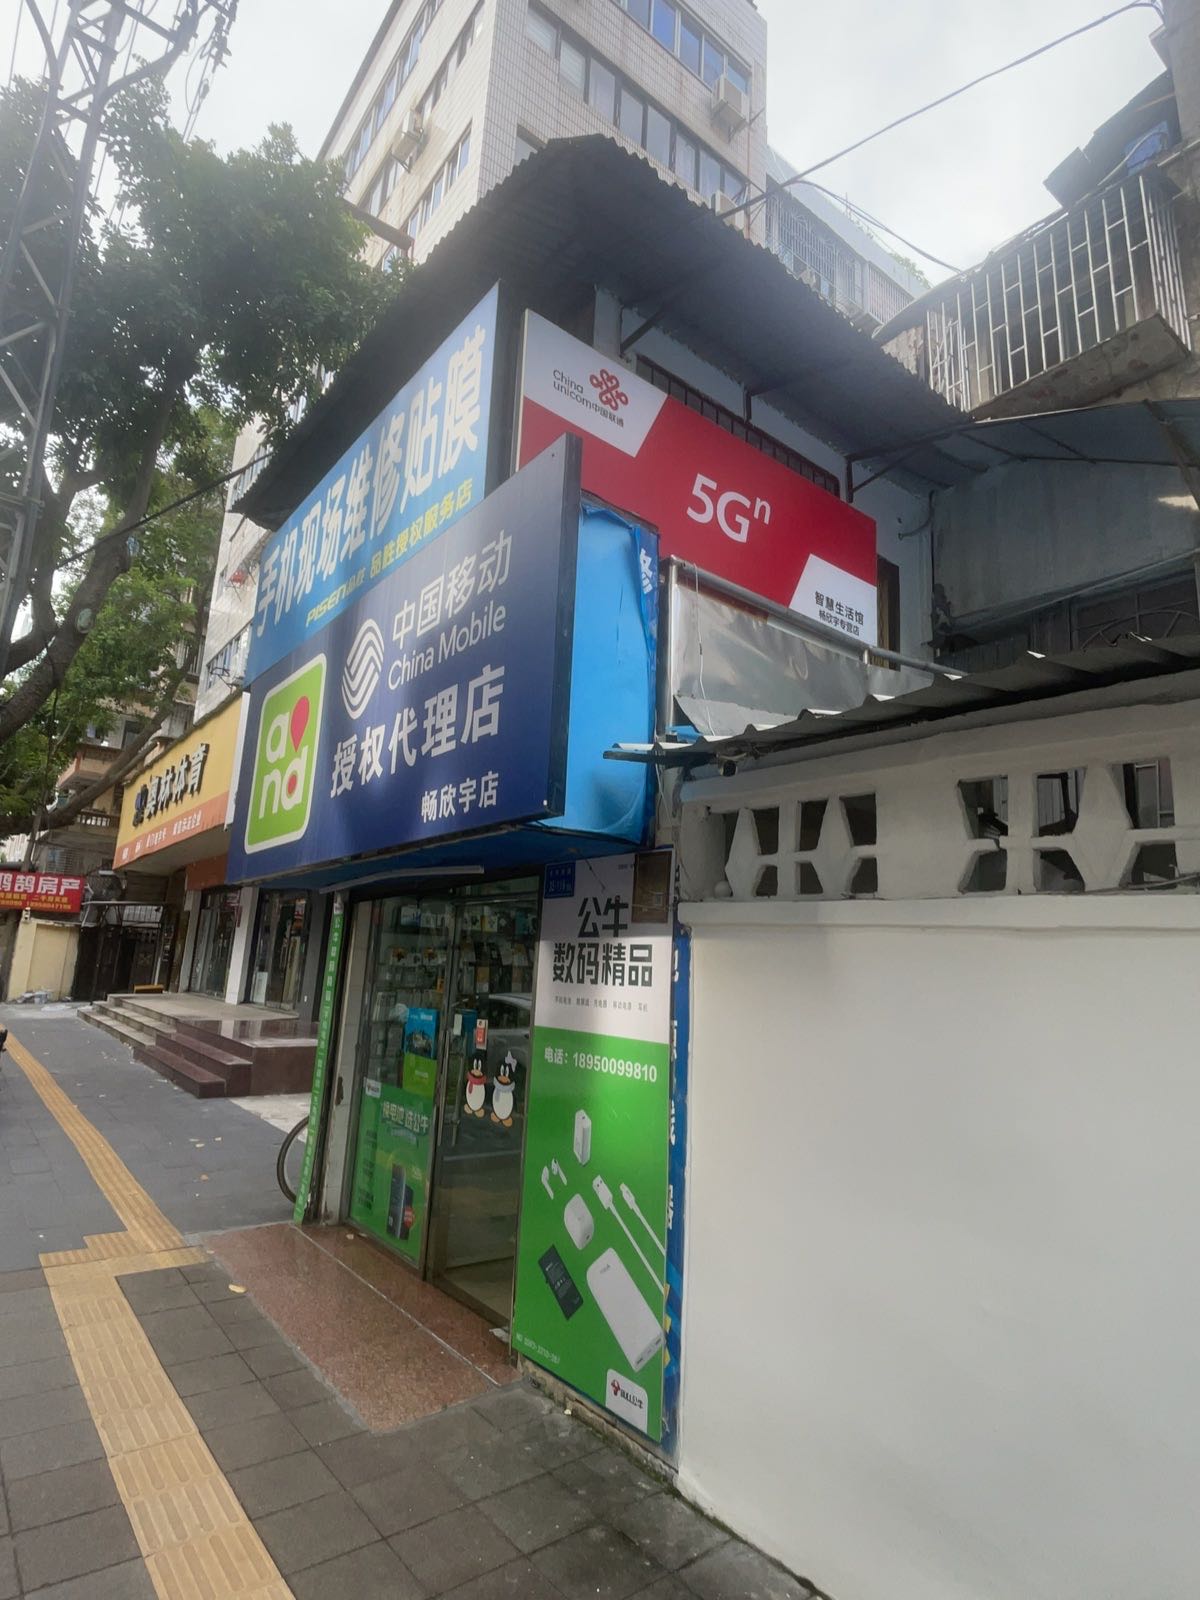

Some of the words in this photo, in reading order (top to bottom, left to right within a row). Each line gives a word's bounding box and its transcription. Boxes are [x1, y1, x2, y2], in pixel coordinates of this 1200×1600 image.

[553, 369, 584, 394] China
[553, 380, 592, 409] unicom
[257, 325, 486, 638] 手机现场维修贴膜
[370, 479, 473, 578] 品胜授权服务店
[392, 530, 512, 648] 中国移动
[815, 591, 864, 626] 智慧生活馆
[388, 646, 435, 691] China
[438, 600, 507, 664] Mobile
[330, 664, 505, 798] 授权代理店
[146, 742, 209, 818] 奥林体育
[421, 771, 499, 823] 畅欣宇店
[578, 895, 629, 938] 公牛
[552, 943, 653, 987] 数码精品
[573, 1052, 658, 1083] 18950099810
